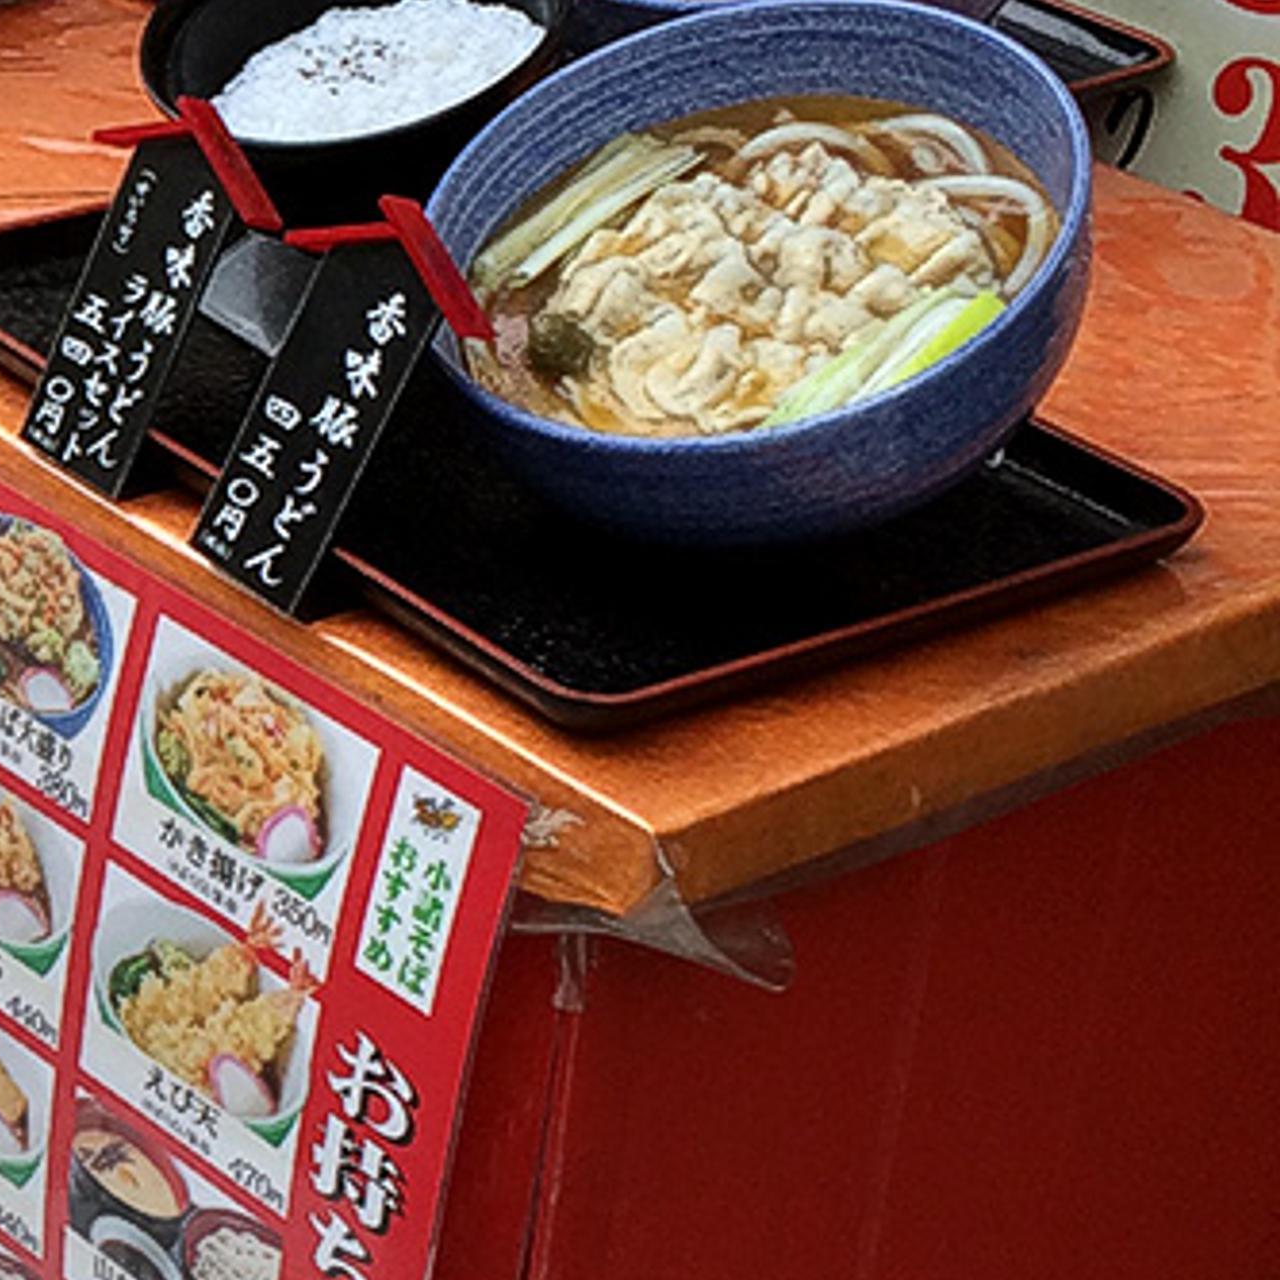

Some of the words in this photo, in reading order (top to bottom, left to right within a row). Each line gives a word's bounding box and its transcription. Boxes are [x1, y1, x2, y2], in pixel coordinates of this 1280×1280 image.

[61, 275, 148, 462] ライスセット
[85, 190, 215, 470] 香味豚うどん
[244, 293, 407, 587] 香味豚うどん
[158, 816, 266, 902] かき揚げ
[362, 836, 418, 972] おすすめ
[144, 1066, 222, 1140] えび天
